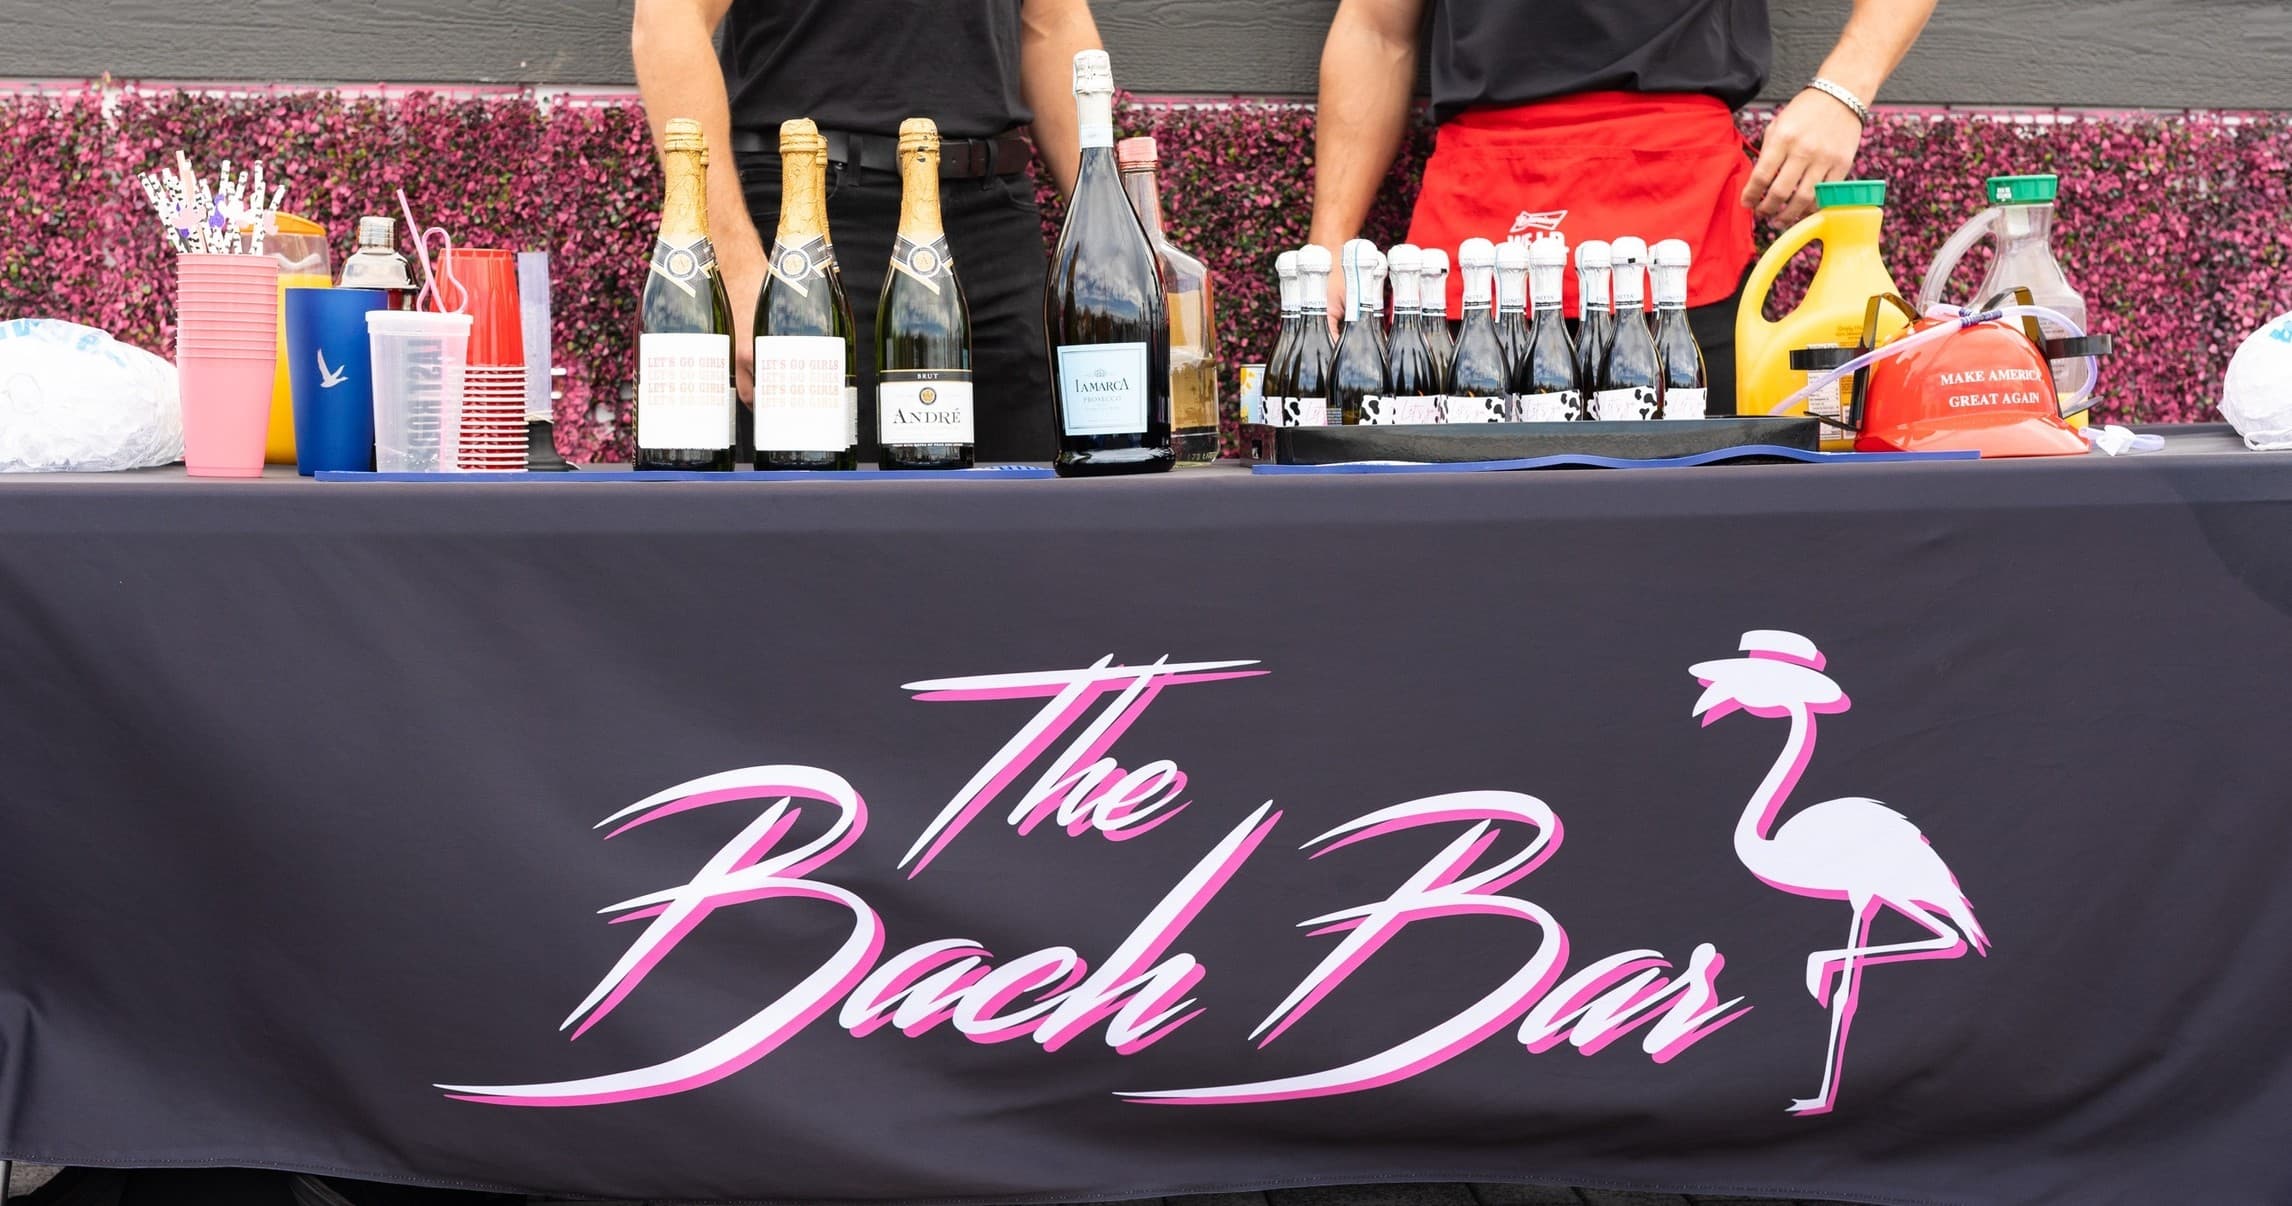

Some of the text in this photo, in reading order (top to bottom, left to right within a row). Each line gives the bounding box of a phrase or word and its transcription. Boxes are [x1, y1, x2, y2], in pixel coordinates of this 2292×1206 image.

[680, 357, 695, 368] GO
[761, 359, 839, 370] LET'S GO GIRLS
[1940, 370, 1985, 386] MAKE
[790, 384, 805, 396] GO
[1948, 392, 2040, 408] GREAT AGAIN
[893, 407, 961, 425] ANDRÉ
[897, 653, 1270, 880] The
[433, 765, 1754, 1106] Bach Bar
